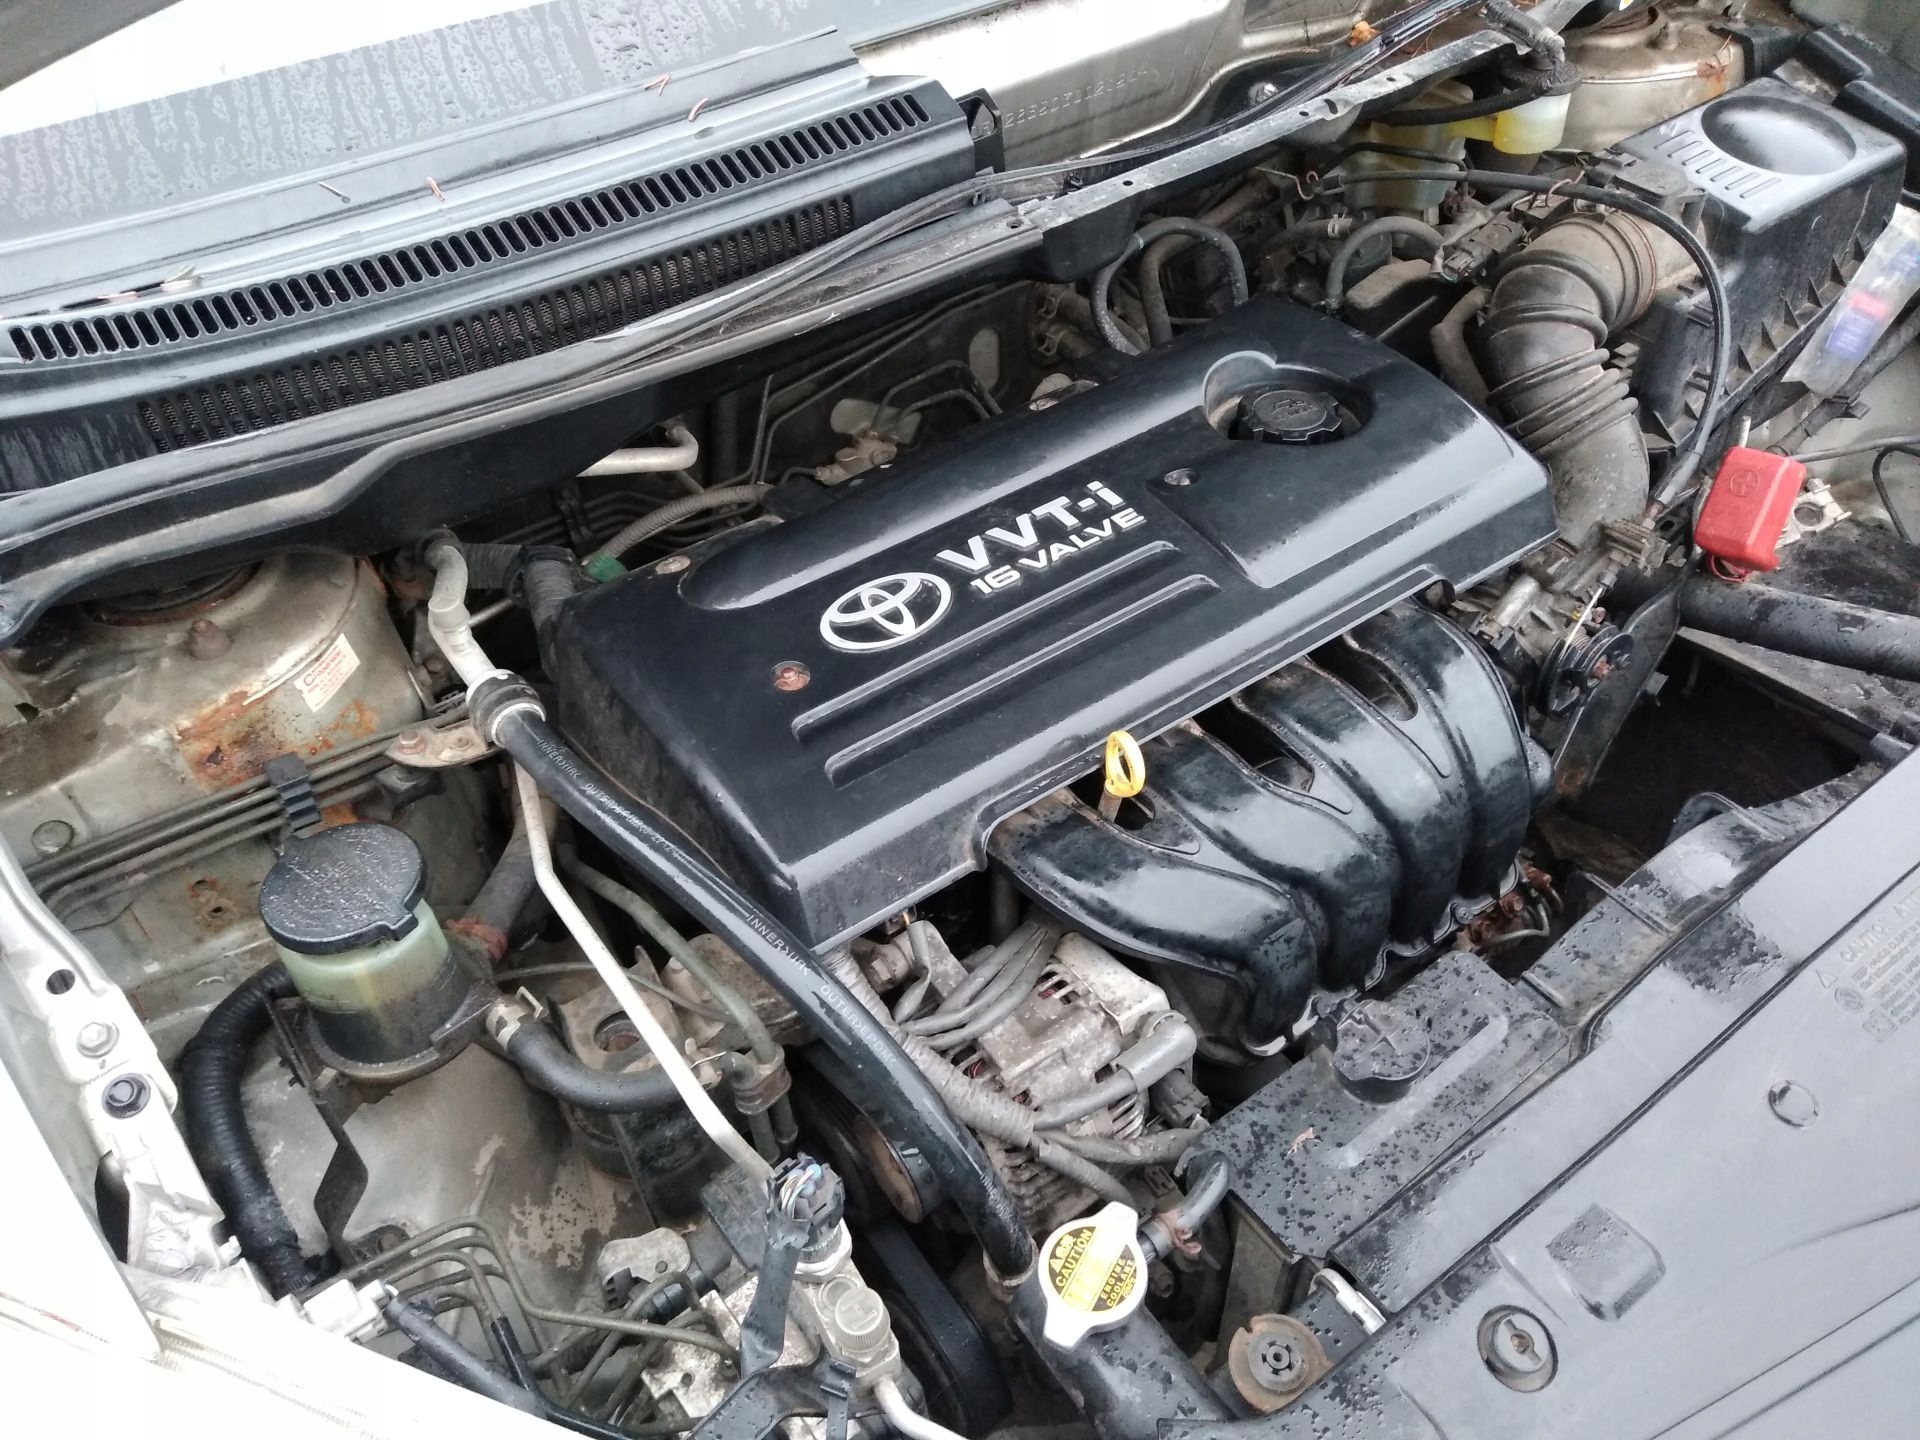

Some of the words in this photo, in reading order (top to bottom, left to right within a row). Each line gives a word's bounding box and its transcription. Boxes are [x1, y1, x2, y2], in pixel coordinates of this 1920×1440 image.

[935, 480, 1125, 573] VVT-i
[969, 564, 1021, 596] 16
[1018, 507, 1147, 564] VALVE
[1055, 1228, 1093, 1288] CAUTION
[1100, 1257, 1127, 1300] ENGINE
[1106, 1259, 1135, 1308] COOLANT
